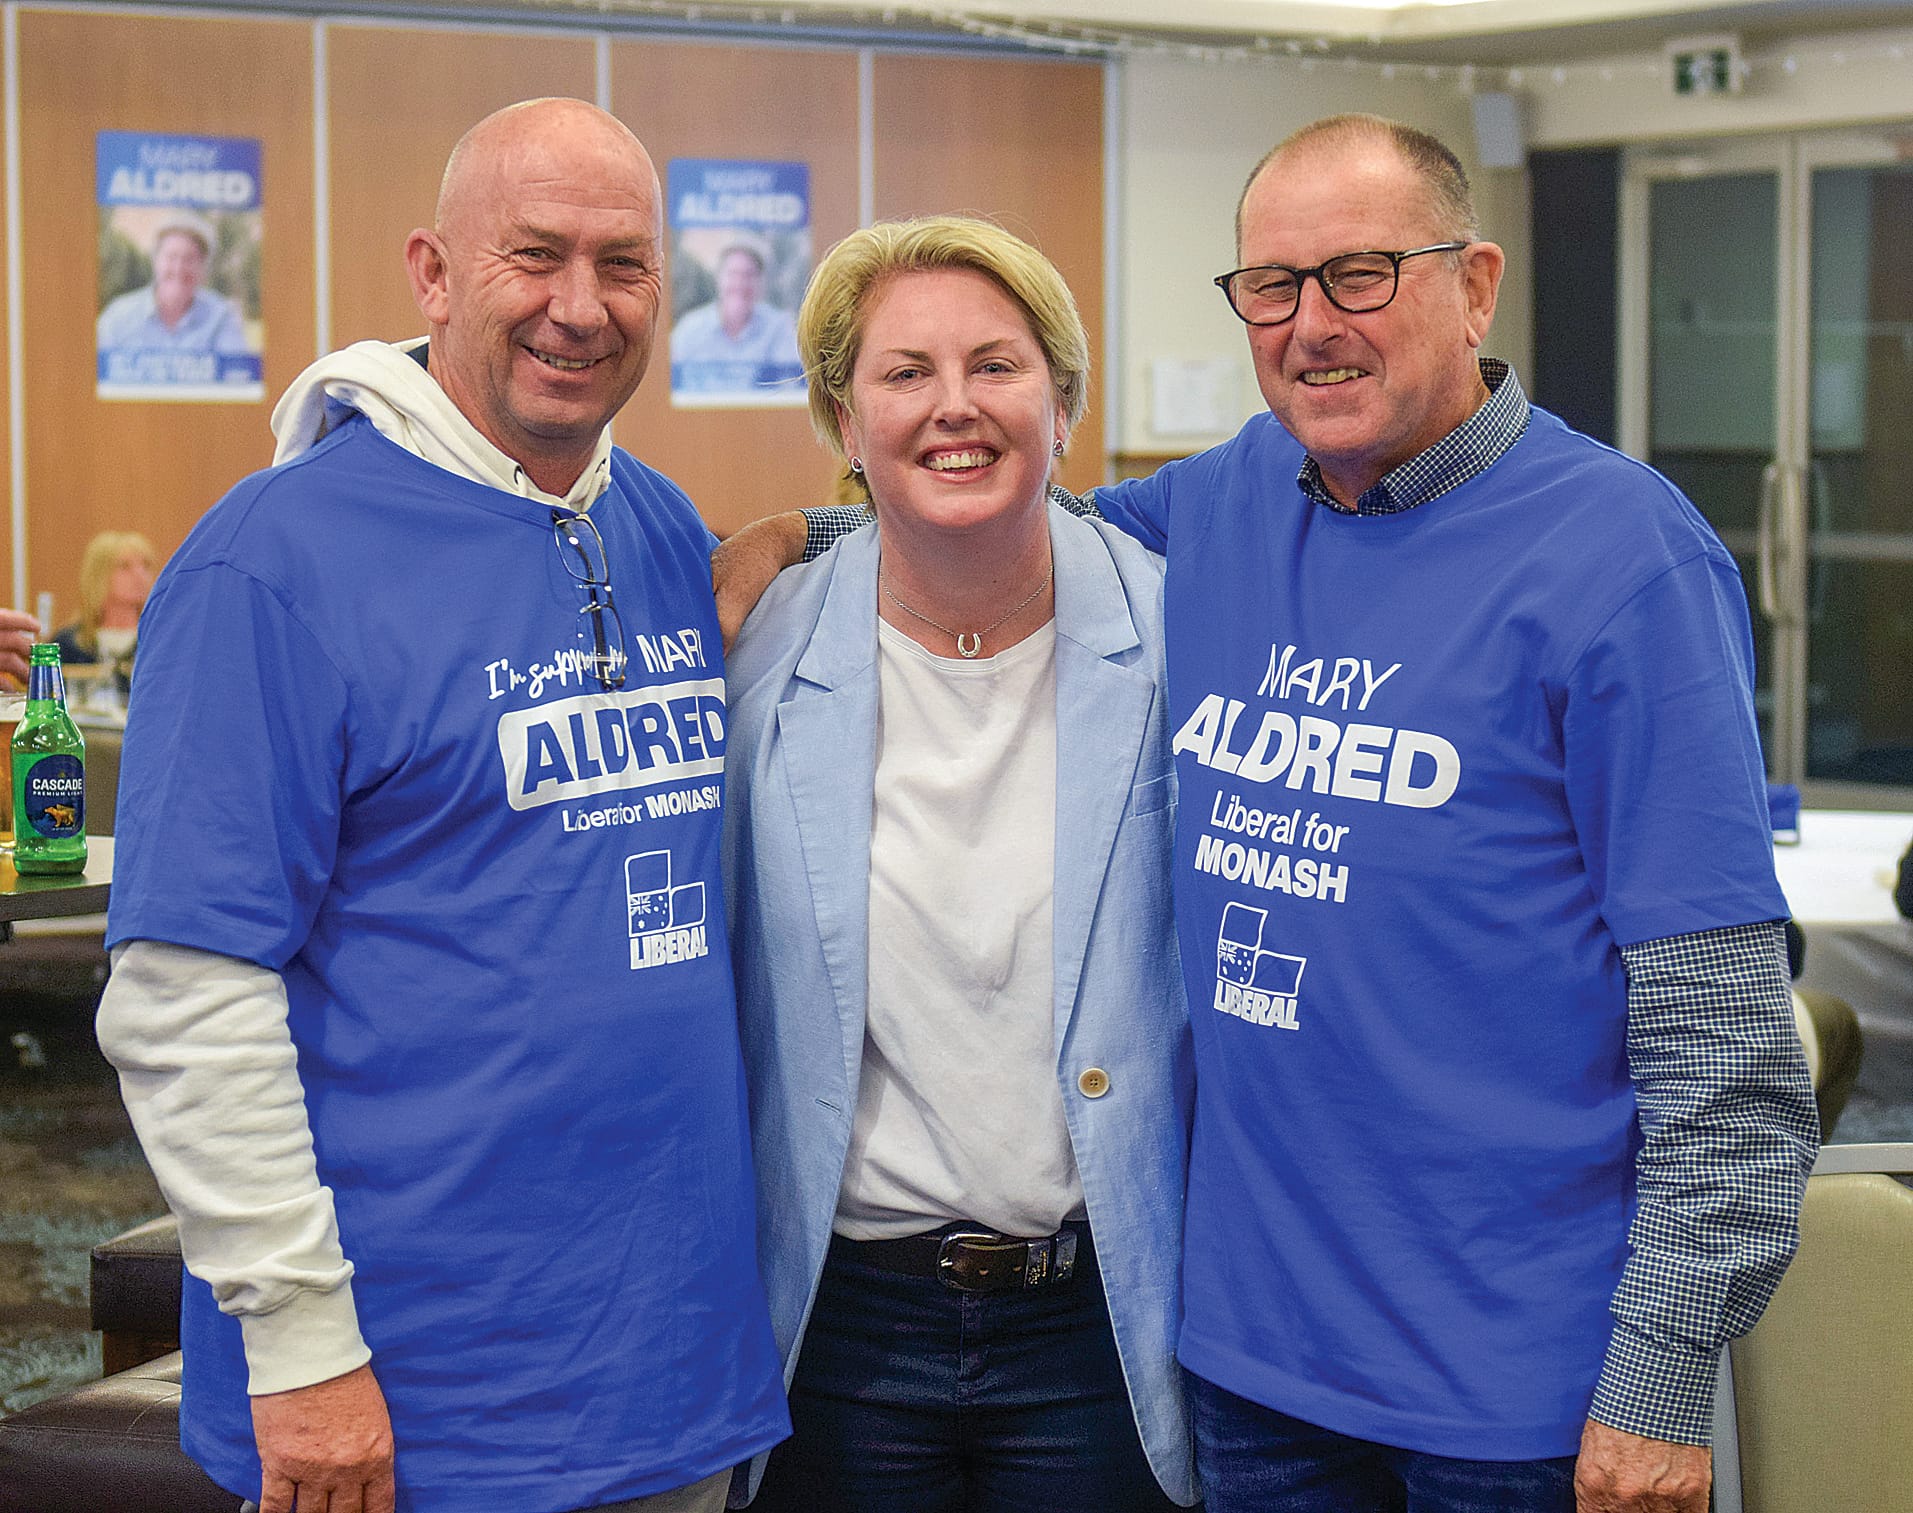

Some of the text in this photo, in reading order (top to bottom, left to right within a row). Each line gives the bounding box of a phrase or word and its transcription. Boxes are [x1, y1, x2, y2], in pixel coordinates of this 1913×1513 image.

[109, 167, 254, 203] ALDRED
[484, 658, 527, 700] I'm
[1256, 643, 1402, 711] MARY
[521, 695, 726, 795] ALDRED
[1172, 693, 1461, 809] ALDRED
[32, 778, 83, 791] CASCADE
[644, 785, 721, 819] MONASH
[1210, 789, 1350, 853] Liberal for
[1194, 834, 1349, 903] MONASH
[629, 925, 709, 970] LIBERAL
[1213, 980, 1300, 1031] LIBERAL
